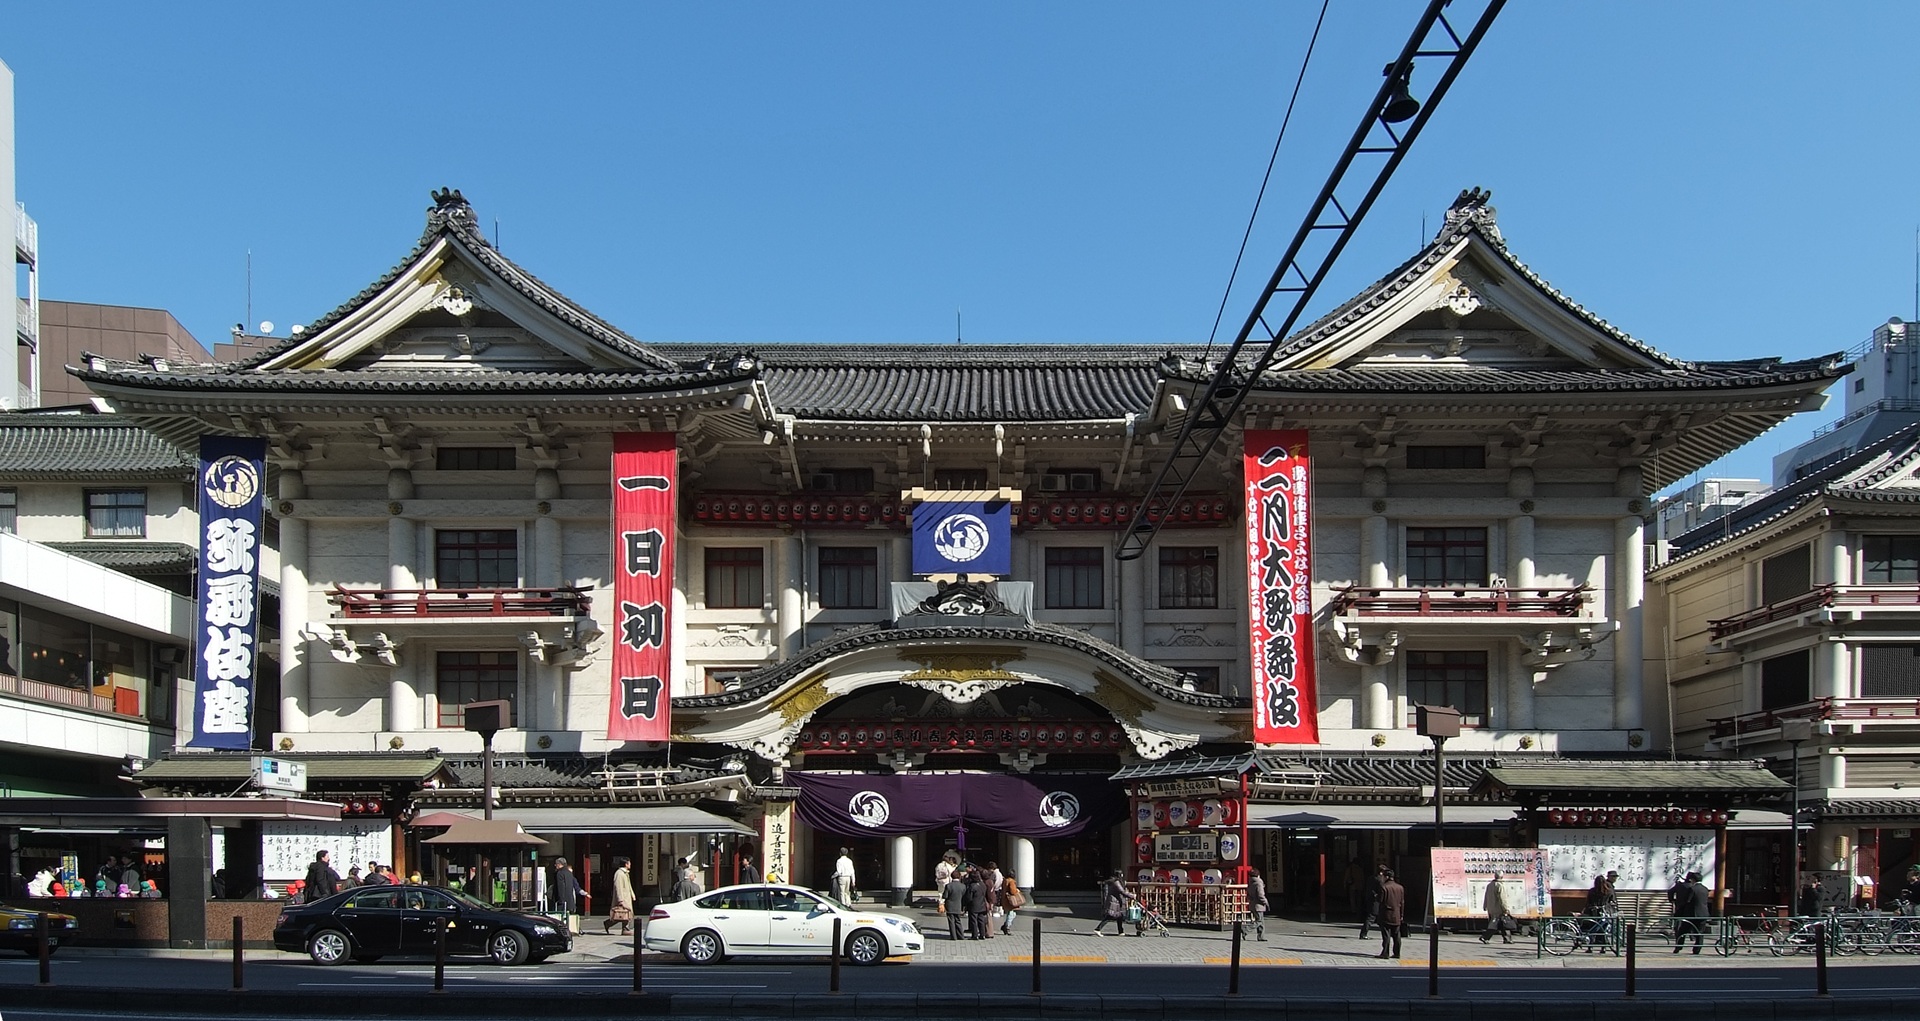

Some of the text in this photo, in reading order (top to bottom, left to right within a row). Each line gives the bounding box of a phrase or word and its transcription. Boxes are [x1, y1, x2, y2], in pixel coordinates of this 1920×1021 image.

[202, 517, 256, 734] 歌舞伎座
[617, 476, 670, 720] 一日初日
[1258, 446, 1300, 728] 二月大歌舞伎
[1292, 465, 1311, 615] 歌舞伎座さよなら公演
[1150, 779, 1216, 793] 歌舞伎座さよなら公演
